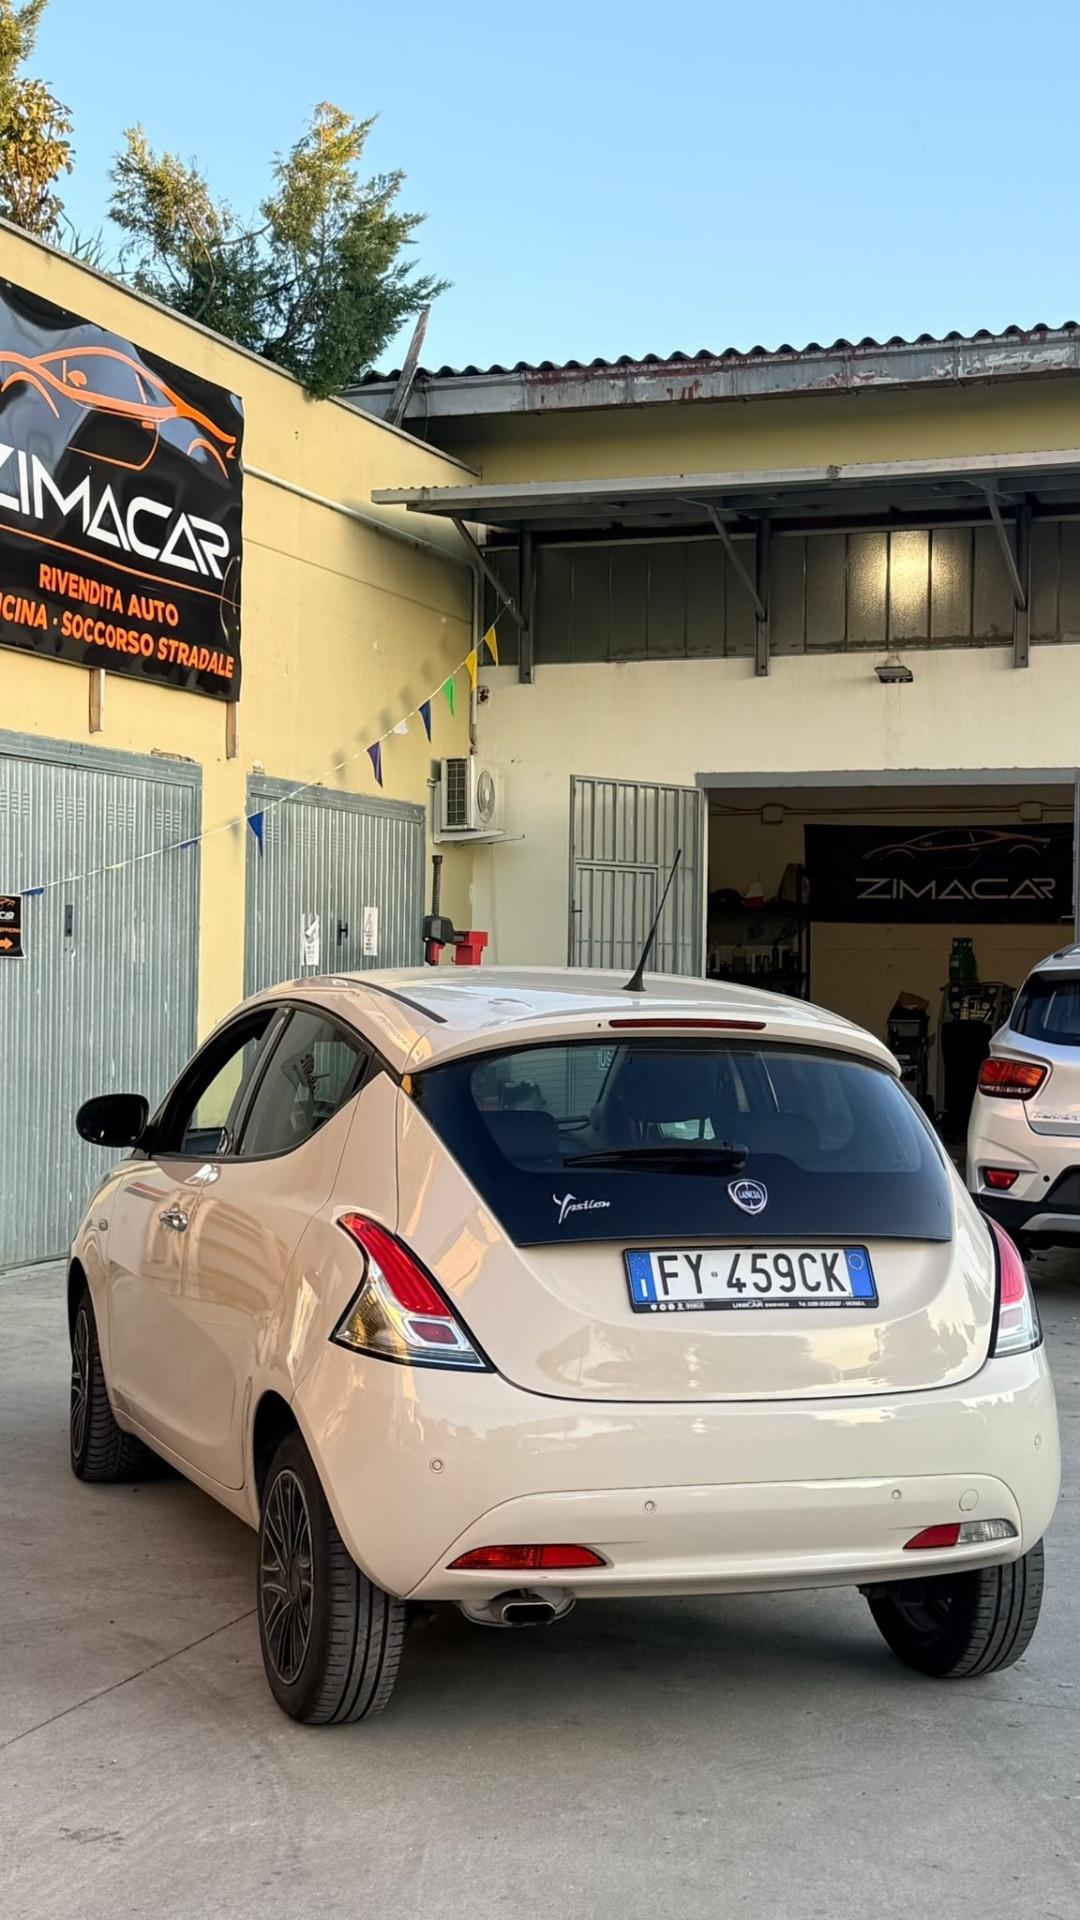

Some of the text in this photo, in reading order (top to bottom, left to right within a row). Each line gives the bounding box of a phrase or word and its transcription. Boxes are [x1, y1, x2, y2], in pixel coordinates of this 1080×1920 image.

[39, 564, 179, 627] RIVENDITA AUTO
[61, 611, 154, 657] SOCCORSO
[157, 637, 235, 679] STRADALE
[855, 877, 1056, 900] ZIMACAR
[552, 1193, 611, 1225] Ypsilon
[657, 1252, 848, 1296] FY 459CK
